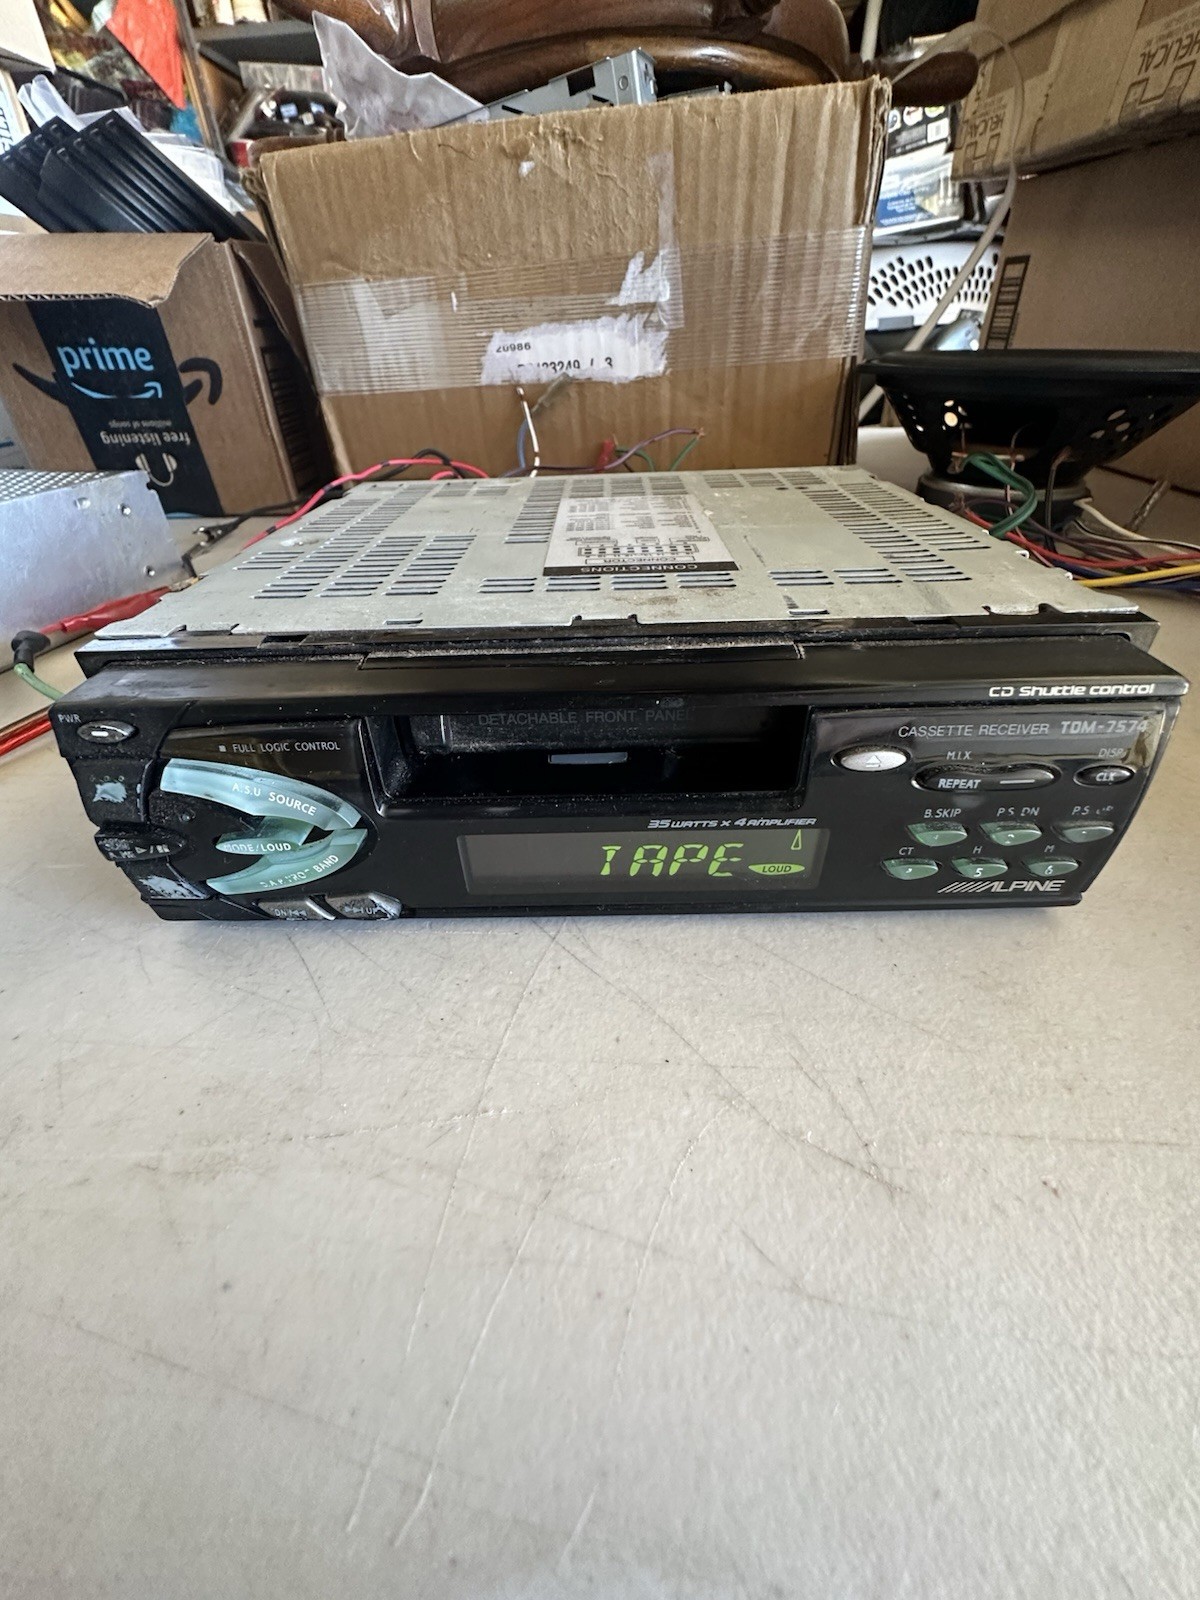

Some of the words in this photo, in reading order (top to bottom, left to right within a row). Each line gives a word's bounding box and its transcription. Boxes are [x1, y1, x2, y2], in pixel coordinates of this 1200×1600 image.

[57, 337, 155, 378] prime
[99, 430, 162, 447] listening
[162, 431, 192, 447] free
[580, 563, 698, 574] CONNECTIONS
[988, 685, 1015, 698] CD
[1018, 684, 1086, 697] Shuttle
[1089, 683, 1156, 696] control
[58, 713, 81, 724] PWR
[477, 711, 578, 726] DETACHABLE
[585, 709, 638, 723] FRONT
[898, 724, 974, 739] CASSETTE
[978, 722, 1050, 736] RECEIVER
[232, 742, 256, 753] FULL
[261, 742, 291, 753] LOGIC
[294, 741, 341, 752] CONTROL
[1095, 771, 1117, 782] CLK
[938, 778, 982, 790] REPEAT
[268, 791, 318, 817] SOURCE
[898, 846, 914, 856] CT
[972, 845, 983, 855] H
[1044, 844, 1055, 853] M
[313, 854, 339, 873] BAND
[600, 842, 745, 877] TAPE
[762, 865, 792, 873] LOUD
[973, 867, 984, 878] 5
[1044, 865, 1054, 876] 6
[971, 879, 1066, 893] ALPINE
